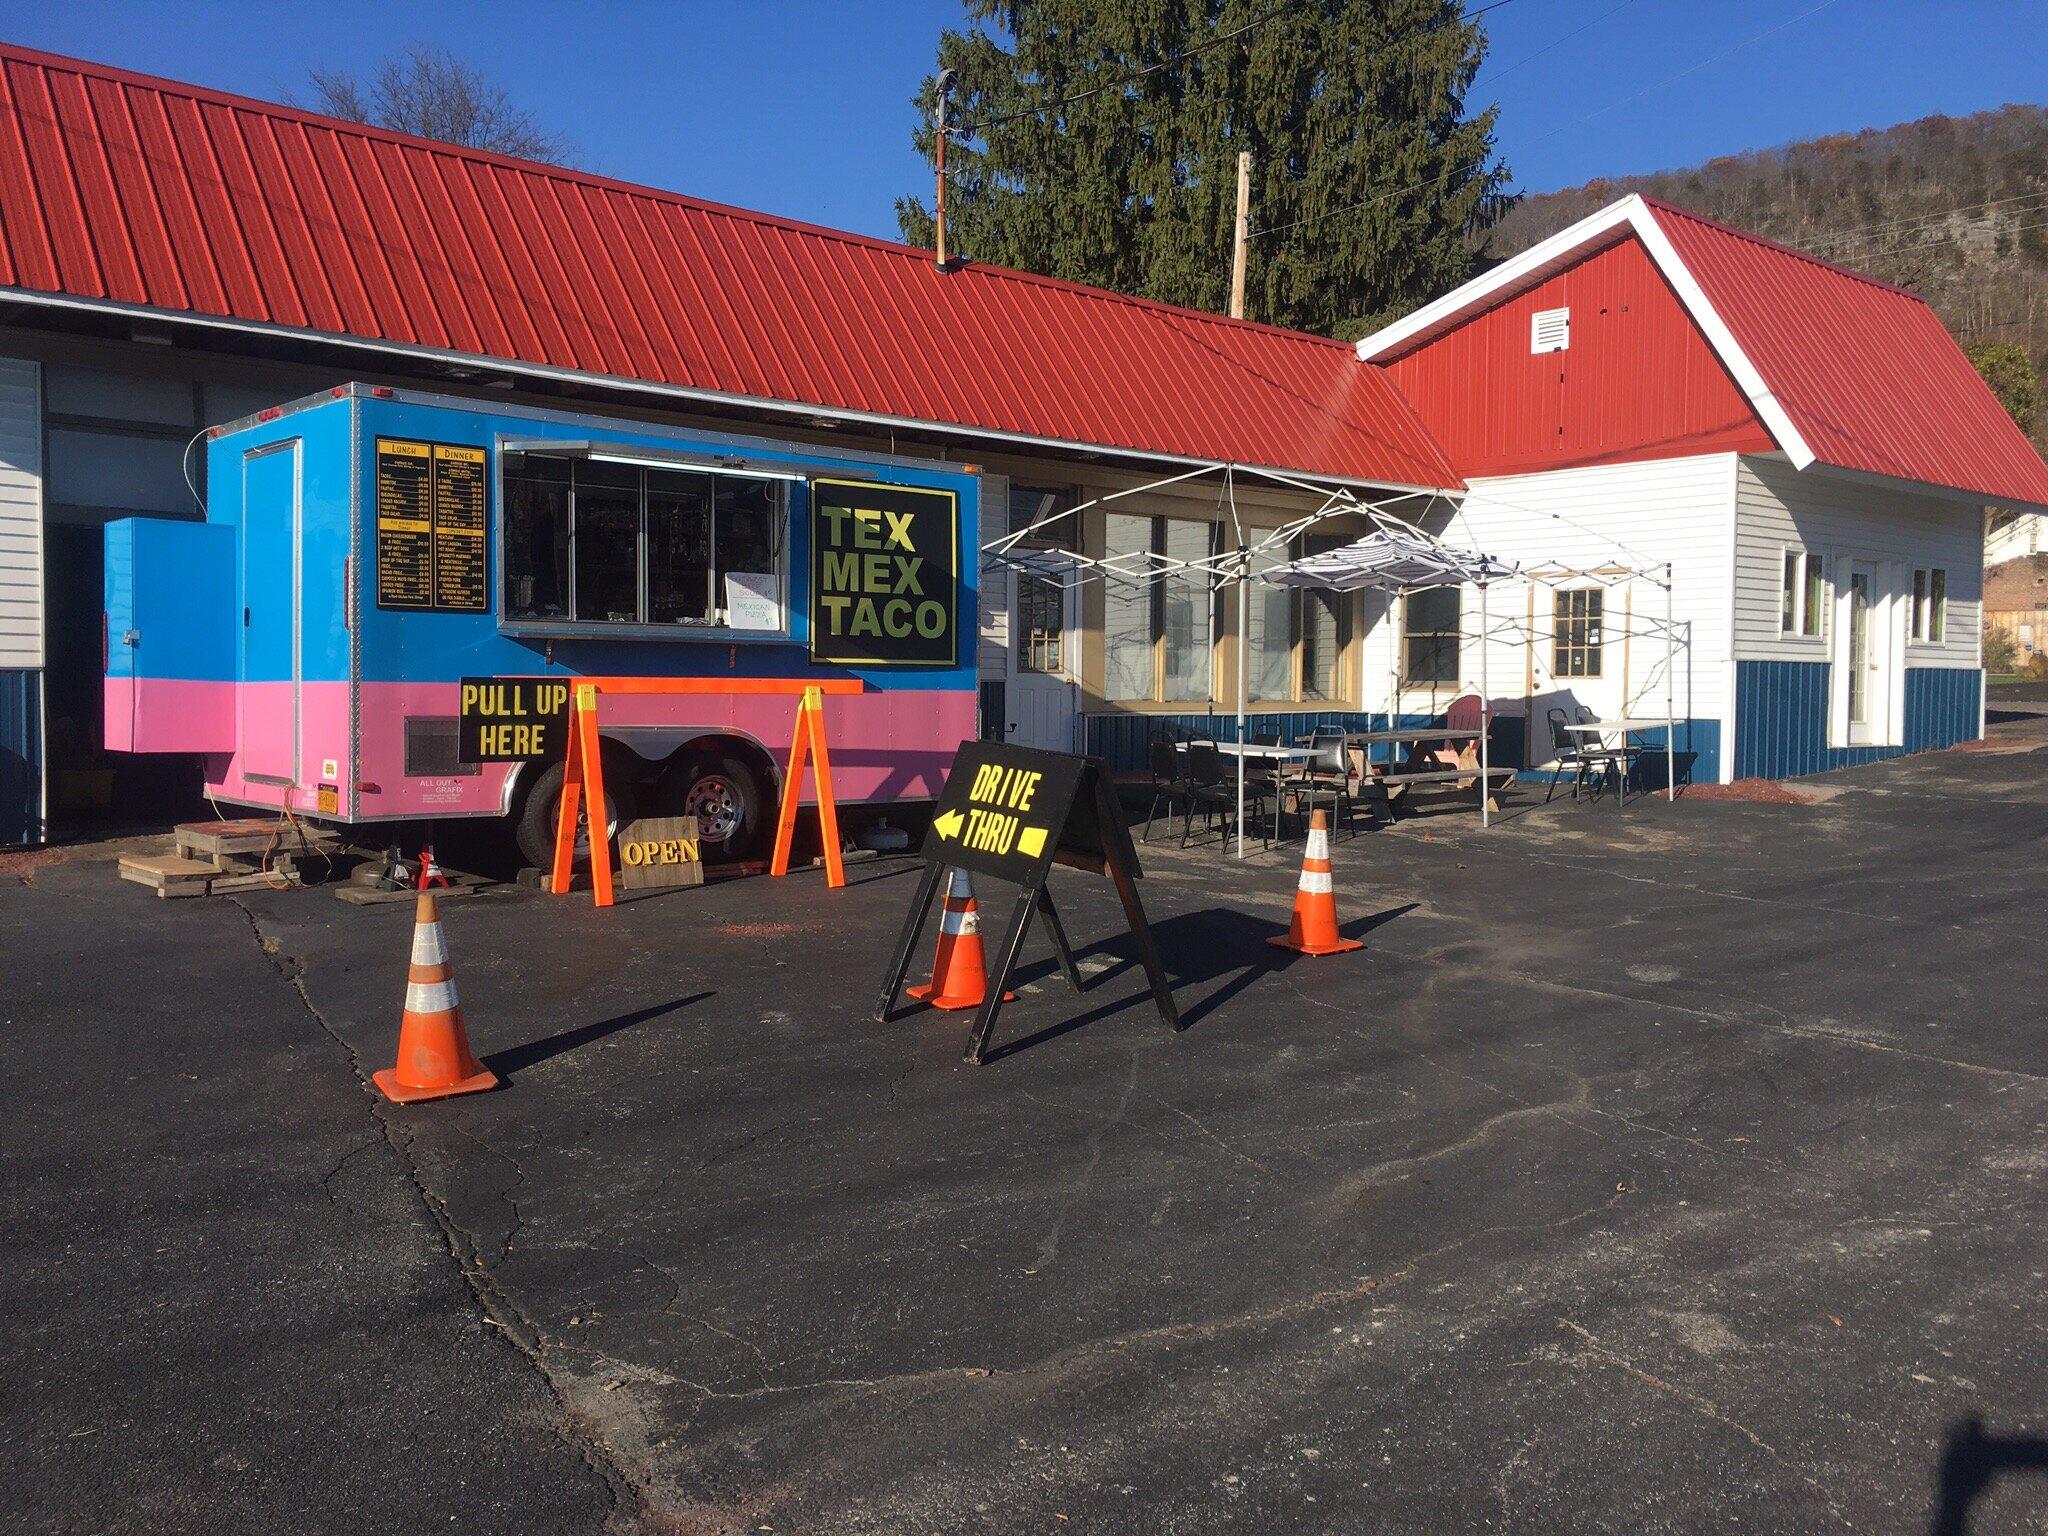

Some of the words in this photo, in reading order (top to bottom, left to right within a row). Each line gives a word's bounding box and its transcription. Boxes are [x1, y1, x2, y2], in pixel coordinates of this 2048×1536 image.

[392, 444, 416, 454] LUNCH
[444, 449, 474, 460] DINNER
[821, 505, 916, 553] TEX
[823, 550, 925, 596] MEX
[821, 595, 947, 639] TACO
[462, 684, 528, 716] PULL
[536, 684, 567, 715] UP
[480, 724, 546, 756] HERE
[436, 779, 452, 787] OUT
[969, 763, 1042, 812] DRIVE
[963, 808, 1019, 855] THRU
[622, 836, 700, 867] OPEN
